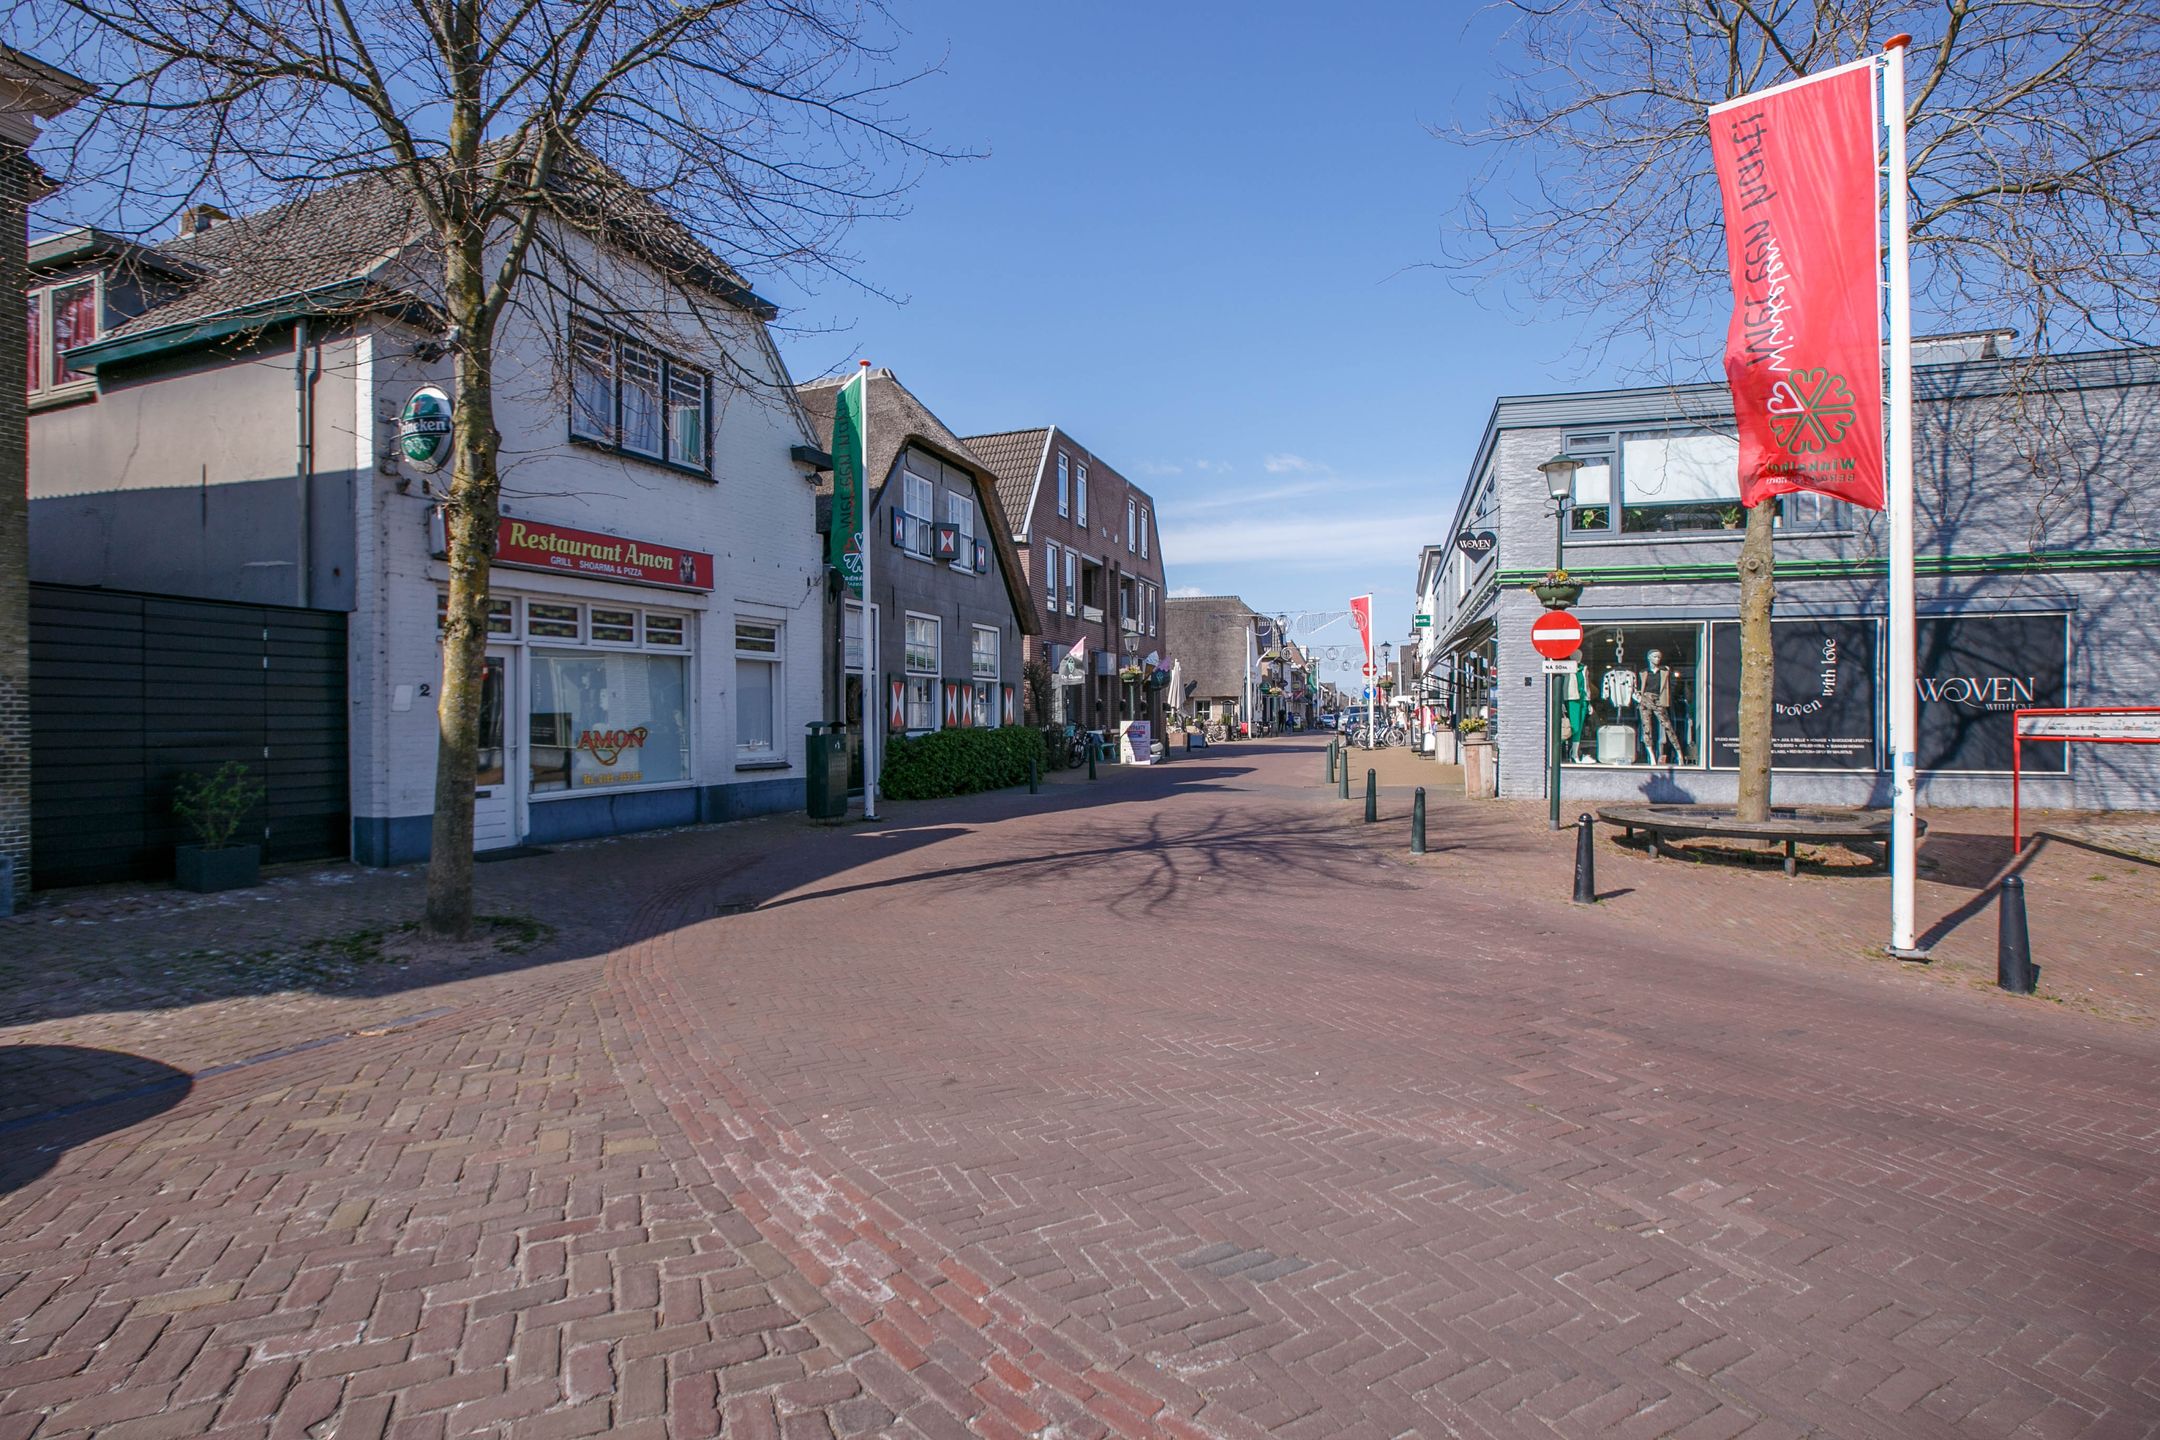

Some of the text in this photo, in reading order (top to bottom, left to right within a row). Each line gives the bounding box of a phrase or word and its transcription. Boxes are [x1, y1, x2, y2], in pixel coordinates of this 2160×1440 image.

[510, 522, 674, 571] Restaurant Amon
[1459, 539, 1491, 549] WOVEN
[550, 555, 643, 577] GRILL SHOARMA & PIZZA
[419, 683, 432, 697] 2
[1775, 638, 1837, 717] woven with love
[1914, 677, 2036, 705] WOVEN
[1985, 703, 2009, 711] WITH
[577, 727, 648, 757] AMON
